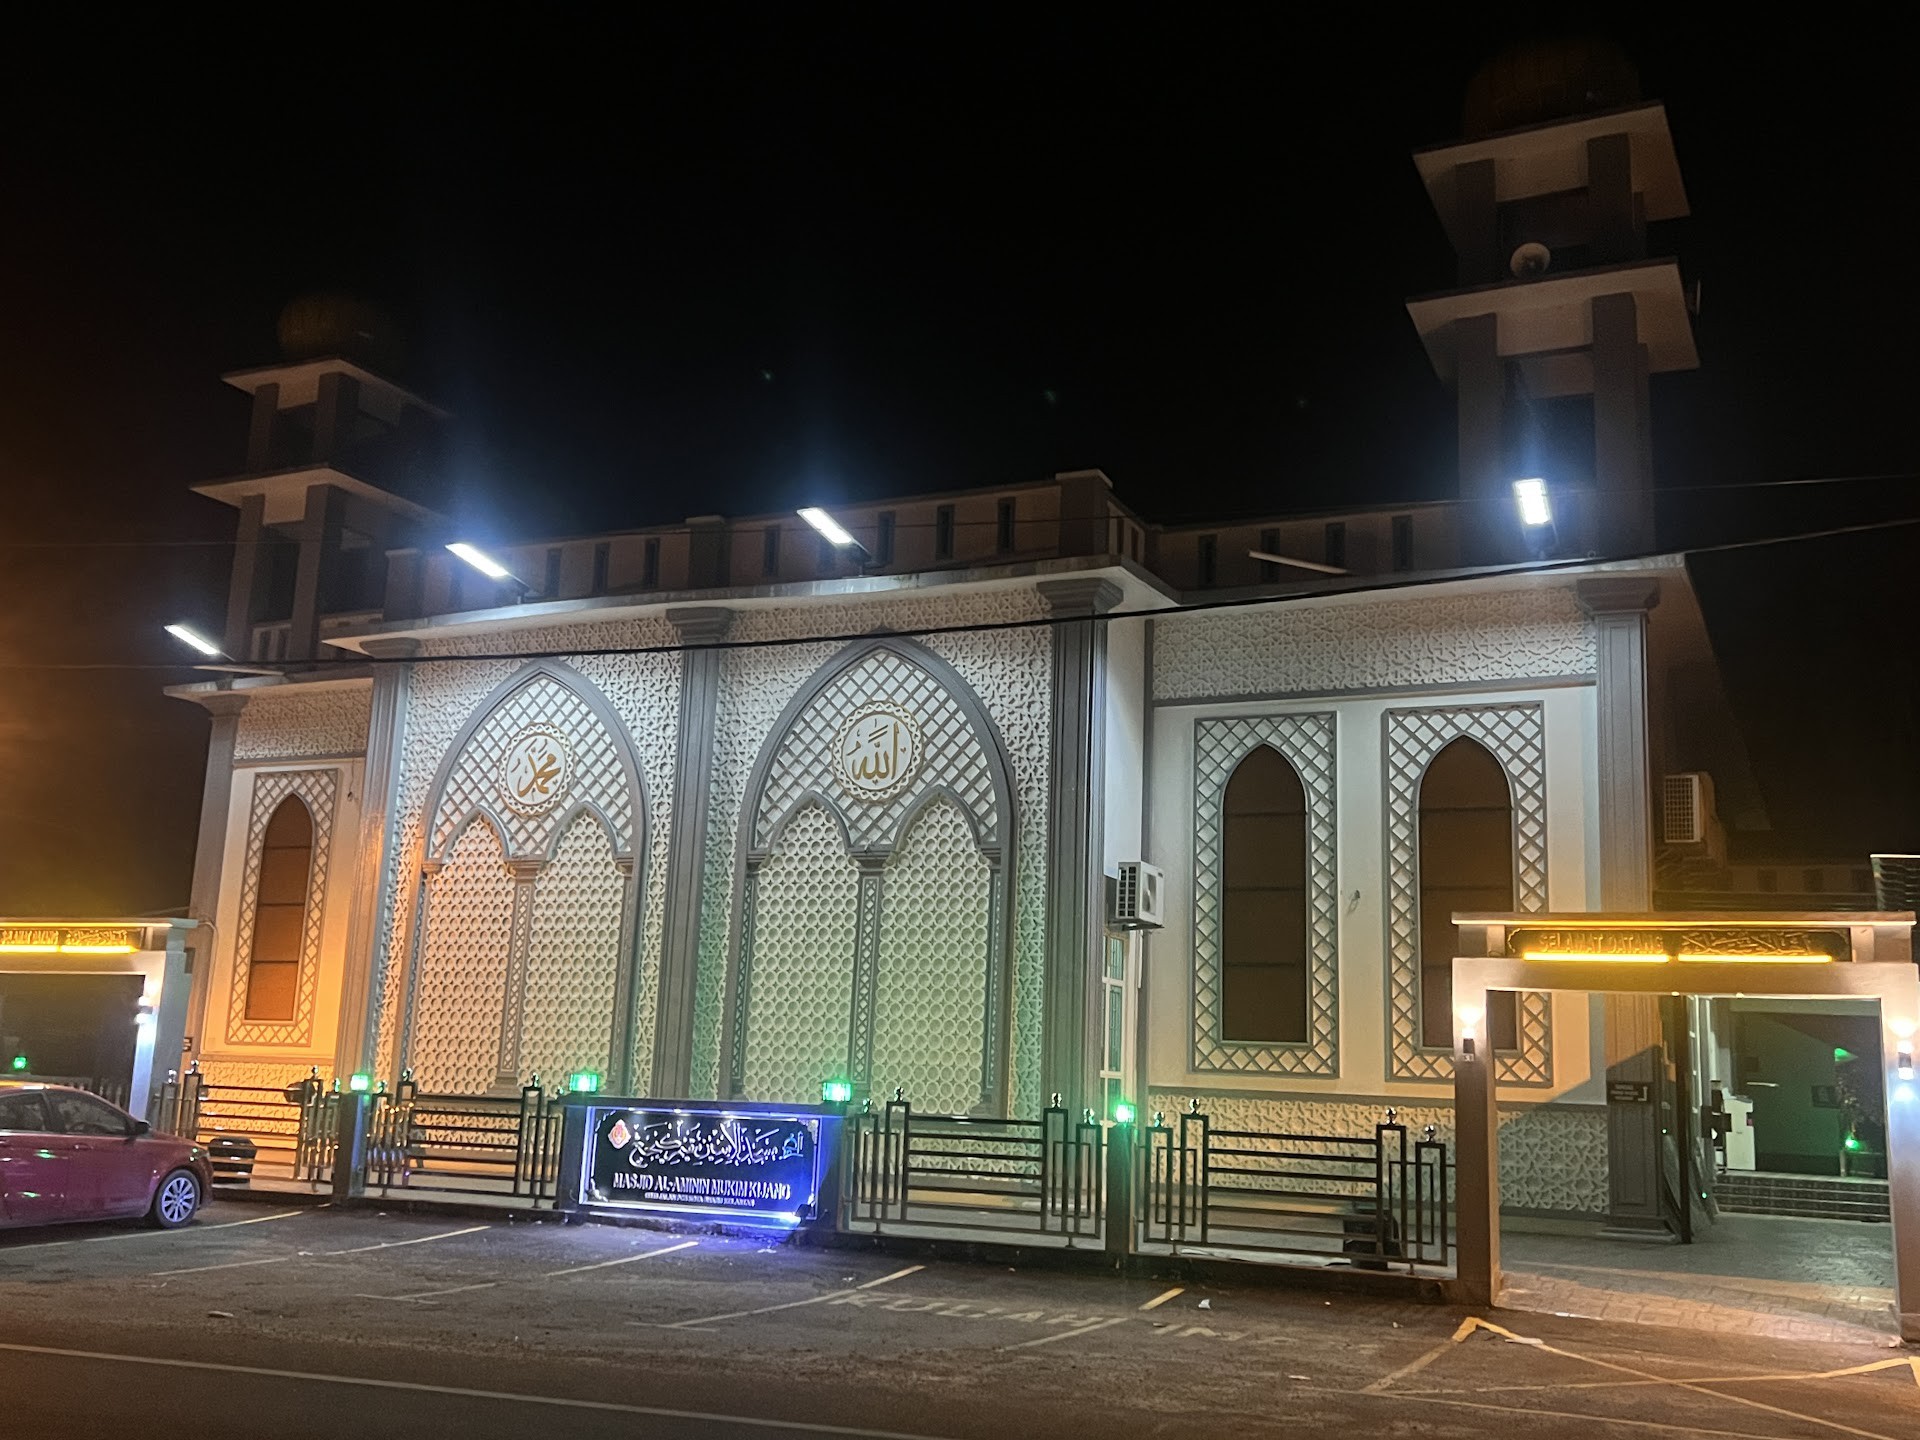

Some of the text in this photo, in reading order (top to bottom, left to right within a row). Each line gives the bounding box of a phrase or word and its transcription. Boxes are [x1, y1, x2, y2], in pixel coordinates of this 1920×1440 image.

[1538, 932, 1604, 953] SELAMAT
[1607, 932, 1664, 953] DATANG
[613, 1172, 653, 1190] MASJID
[711, 1178, 748, 1198] MUKIM
